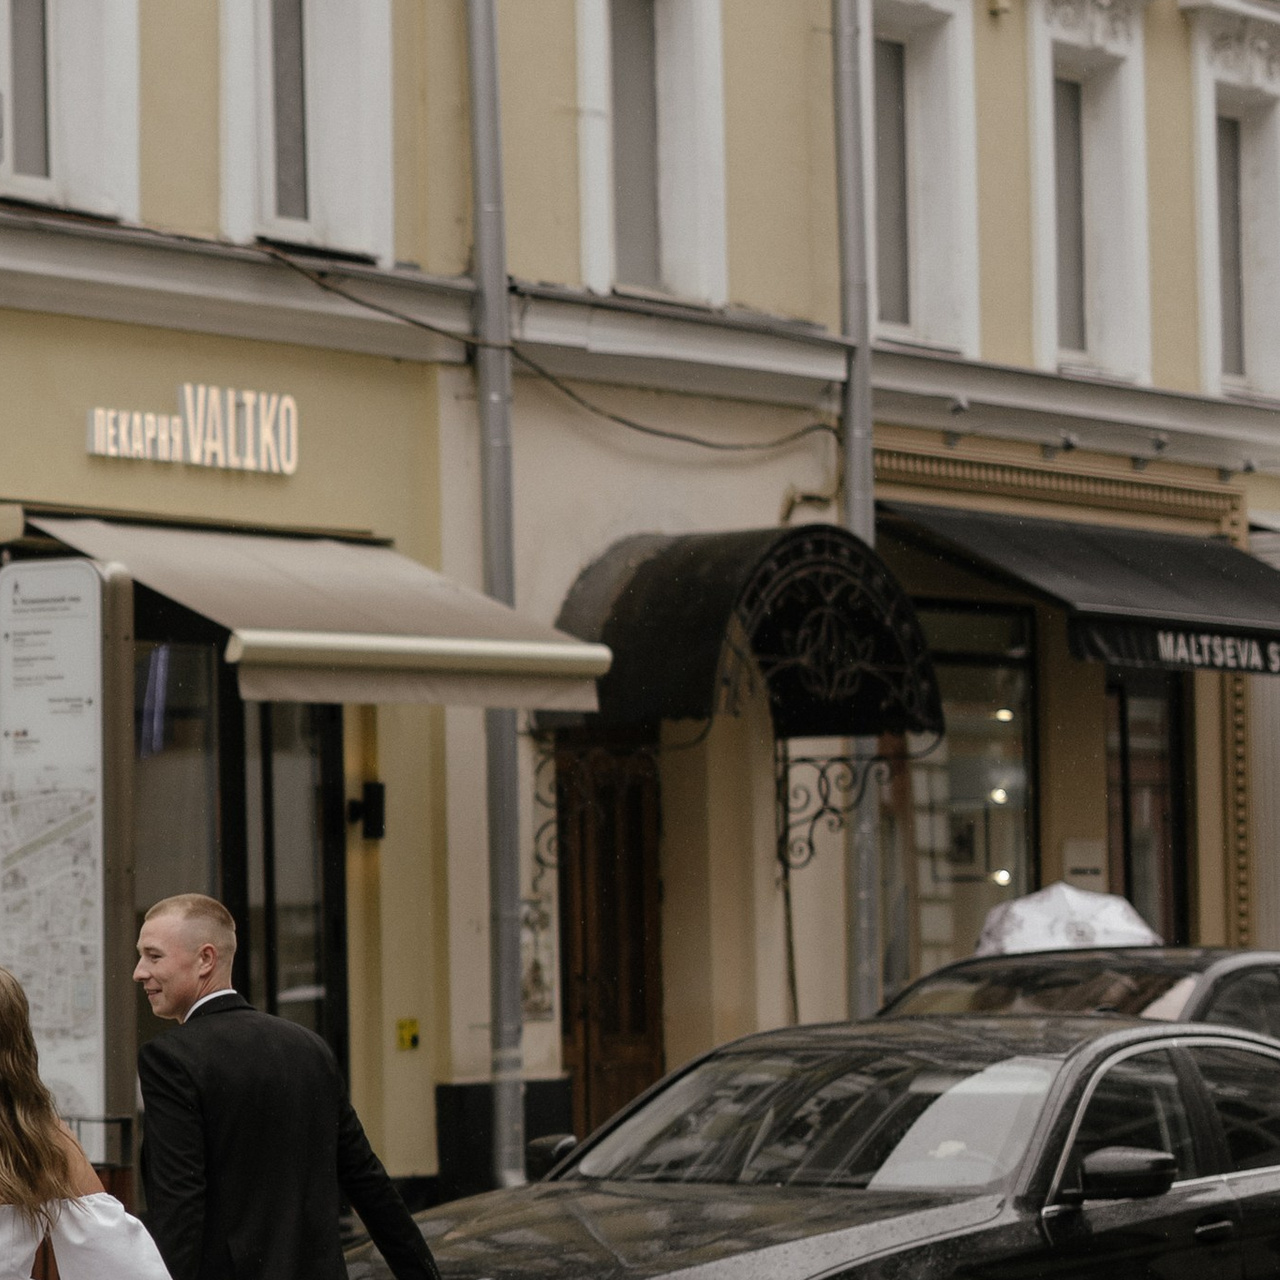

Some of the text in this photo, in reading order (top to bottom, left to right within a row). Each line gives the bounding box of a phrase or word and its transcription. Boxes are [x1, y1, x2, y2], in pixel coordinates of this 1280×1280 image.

[90, 381, 299, 476] ПЕКАРНЯ VALIKO
[1158, 630, 1263, 670] MALTSEVA
